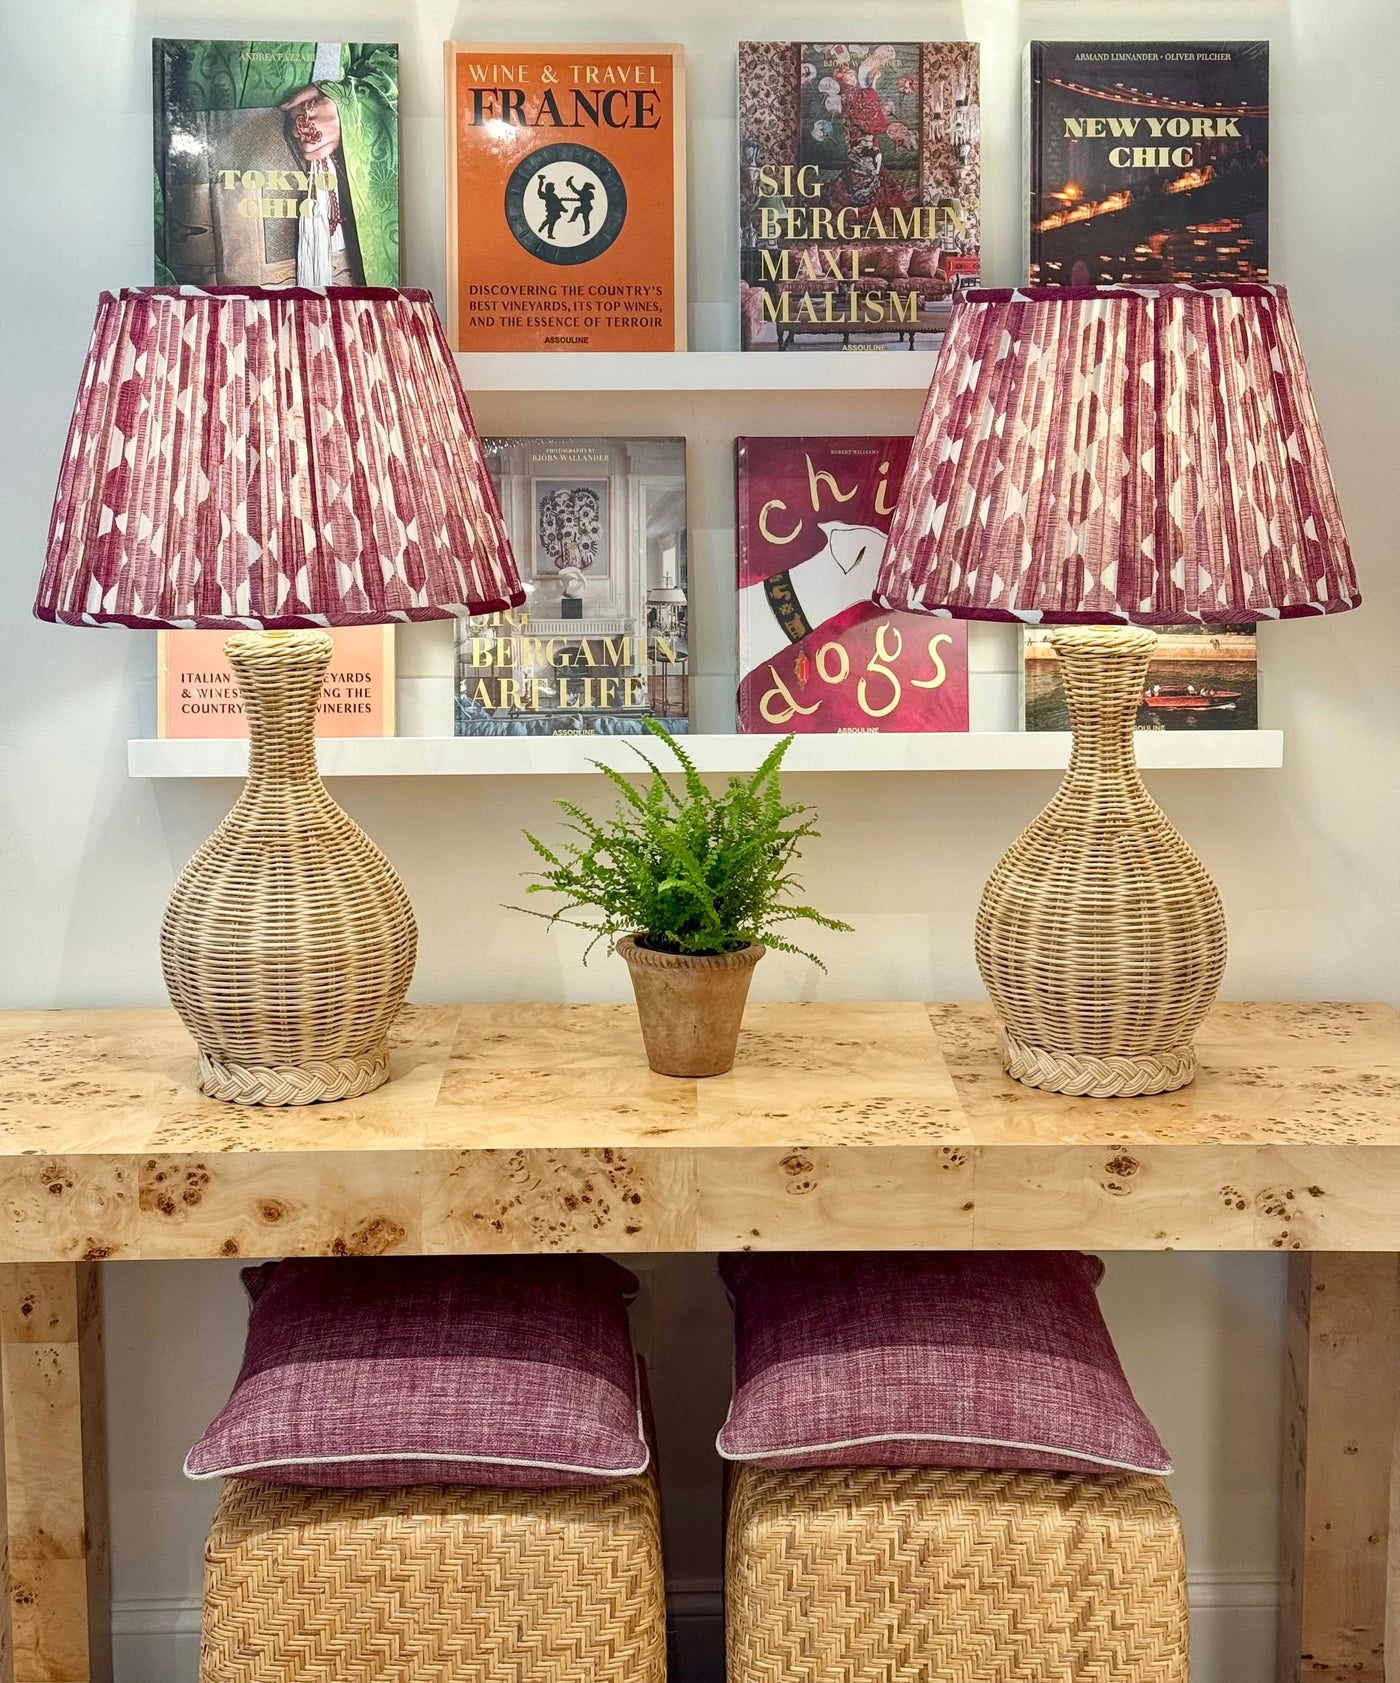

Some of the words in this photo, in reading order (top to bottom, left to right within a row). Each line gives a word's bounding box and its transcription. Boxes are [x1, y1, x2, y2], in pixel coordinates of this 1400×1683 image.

[1074, 53, 1110, 61] ARMAND
[1110, 53, 1159, 61] LIMNANDER
[1164, 53, 1195, 61] OLIVER
[1196, 53, 1232, 61] PILCHER
[468, 64, 530, 83] WINE
[541, 65, 559, 84] &
[569, 65, 661, 84] TRAVEL
[467, 86, 662, 130] FRANCE
[1063, 117, 1141, 138] NEW
[1145, 117, 1242, 138] YORK
[1108, 147, 1194, 168] CHIC
[218, 169, 338, 192] TOKYO
[758, 164, 824, 198] SIG
[238, 198, 321, 219] CHIC
[758, 206, 967, 240] BERGAMIN
[758, 249, 876, 281] MAXI-
[469, 285, 557, 296] DISCOVERING
[560, 285, 585, 297] THE
[469, 301, 498, 312] BEST
[502, 301, 571, 313] VINEYARDS,
[573, 301, 593, 312] ITS
[595, 301, 621, 312] TOP
[623, 301, 663, 313] WINES,
[759, 291, 921, 323] MALISM
[469, 316, 495, 328] AND
[499, 316, 523, 328] THE
[526, 316, 580, 328] ESSENCE
[584, 316, 601, 328] OF
[605, 317, 663, 328] TERROIR
[544, 336, 589, 344] ASSOULINE
[560, 454, 610, 462] WALLANDER
[758, 453, 896, 544] chi
[469, 636, 677, 668] BERGAMIN
[181, 673, 231, 683] ITALIAN
[759, 620, 953, 724] dogs
[181, 688, 192, 698] &
[345, 688, 371, 698] THE
[470, 678, 548, 712] ART
[557, 677, 646, 709] LIFE
